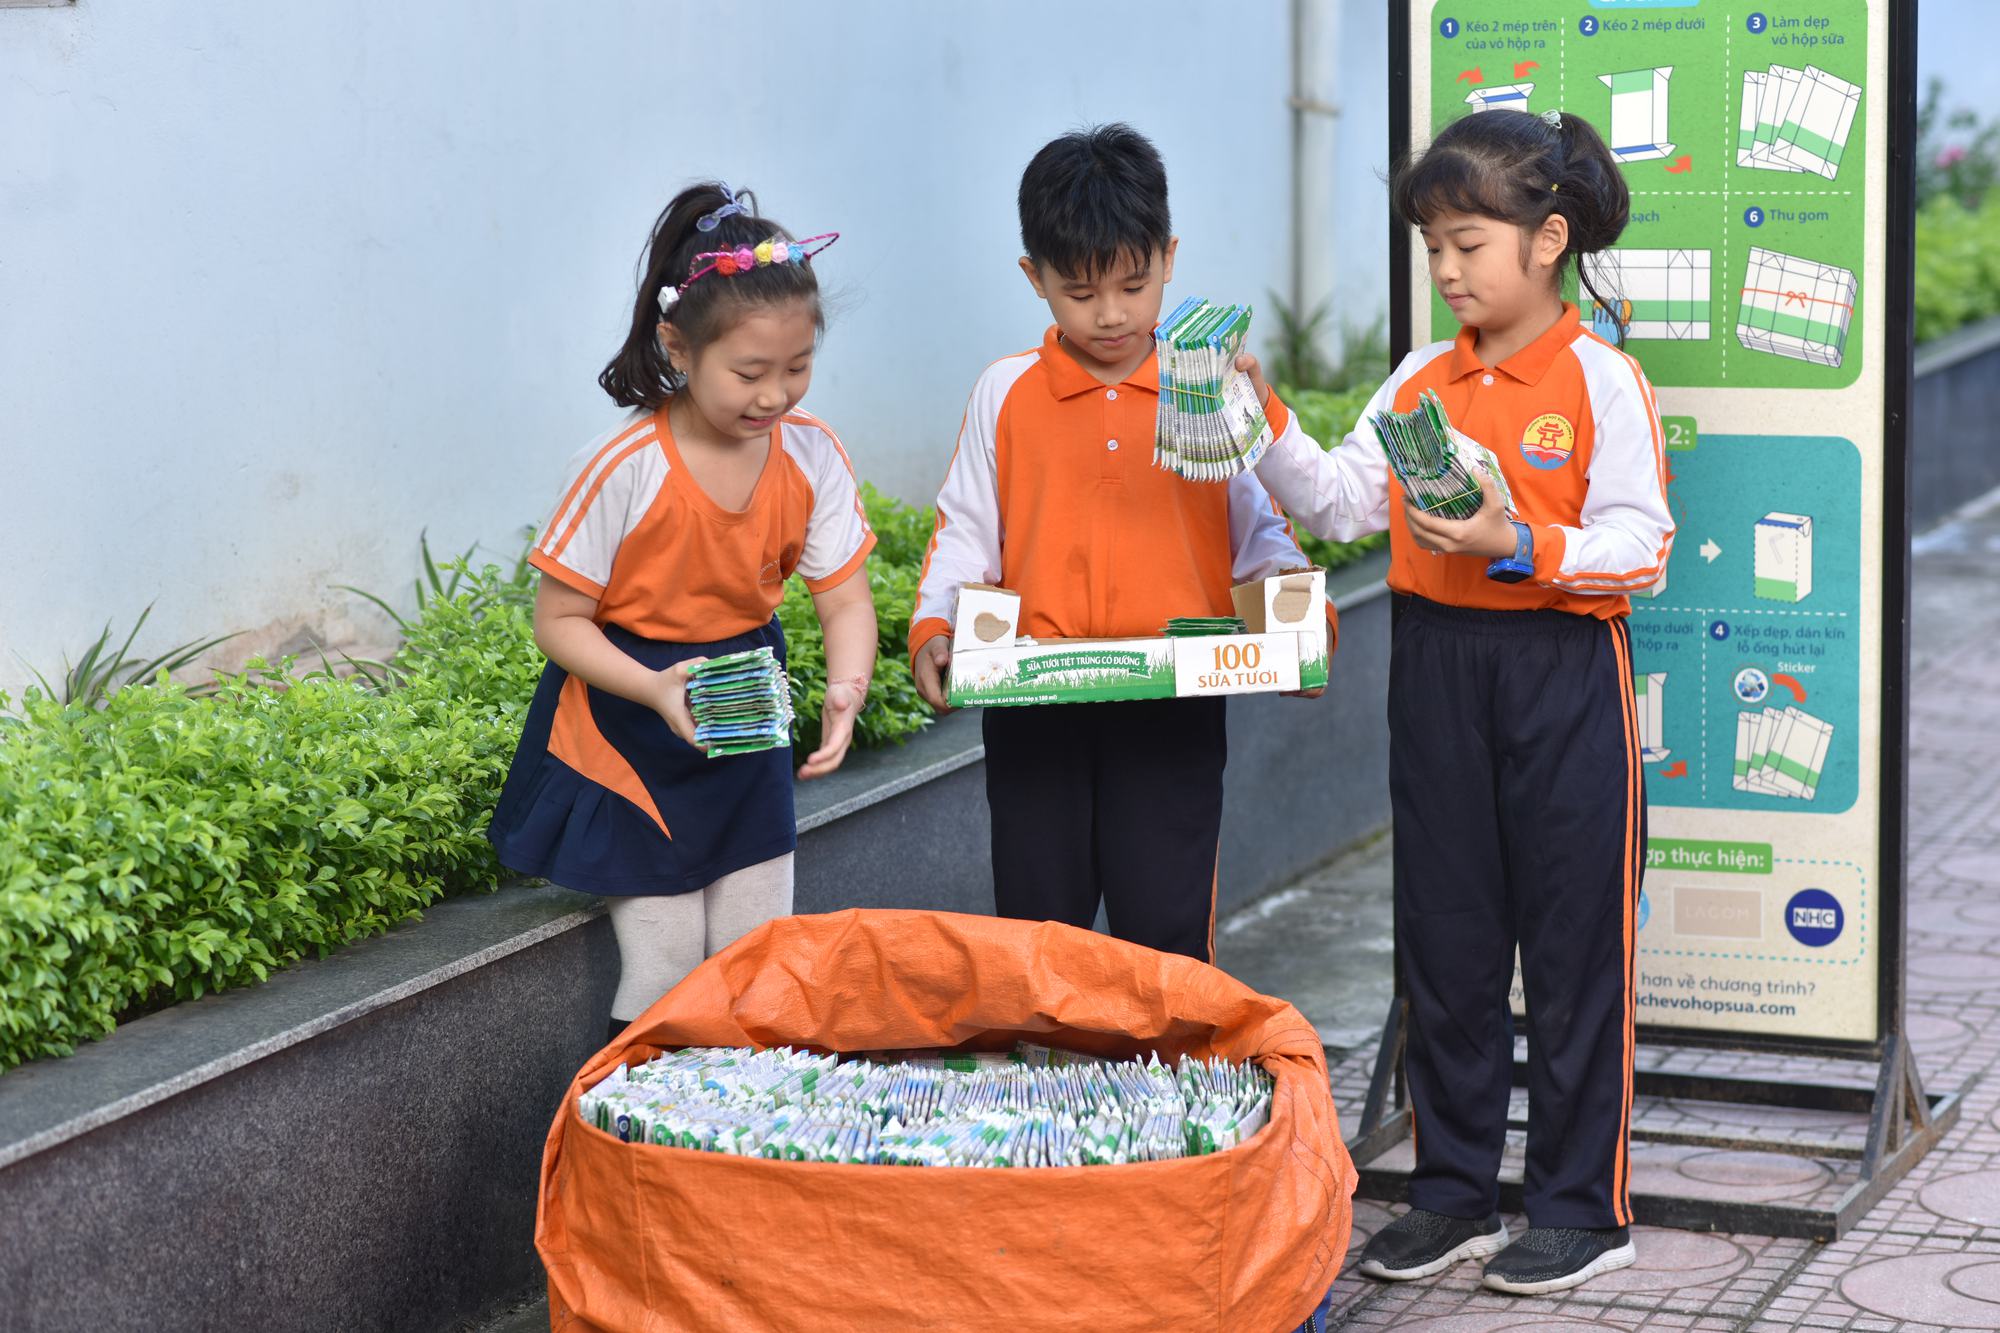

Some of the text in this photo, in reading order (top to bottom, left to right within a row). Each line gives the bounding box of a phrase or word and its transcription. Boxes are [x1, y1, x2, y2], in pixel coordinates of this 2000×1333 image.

[1446, 19, 1557, 34] 1 Kéo 2 mép trên
[1584, 18, 1705, 33] 2 Kéo 2 mép dưới
[1752, 15, 1830, 29] 3 Làm dẹp
[1466, 37, 1487, 49] của
[1507, 37, 1531, 51] hộp
[1534, 39, 1546, 49] ra
[1792, 33, 1818, 47] hộp
[1822, 33, 1845, 45] sữa
[1631, 210, 1660, 223] sạch
[1749, 209, 1829, 223] 6 Thu gom
[1669, 424, 1690, 445] 2:
[1632, 622, 1694, 635] mép dưới
[1715, 623, 1846, 640] 4 Xếp dẹp, dán kín
[1637, 638, 1679, 652] hộp ra
[1753, 641, 1780, 657] ống
[1783, 643, 1806, 656] hút
[1810, 644, 1825, 657] lại
[1026, 654, 1140, 672] SỮA TƯƠI TIỆT TRÙNG CÓ ĐƯỜNG
[1777, 661, 1816, 673] Sticker
[1198, 670, 1278, 688] SỮA TƯƠI
[1646, 847, 1765, 870] ợp thực hiện:
[1794, 908, 1836, 927] NHC
[1641, 972, 1816, 996] hơn về chương trình?
[1636, 992, 1796, 1016] ichevohopsua.com
